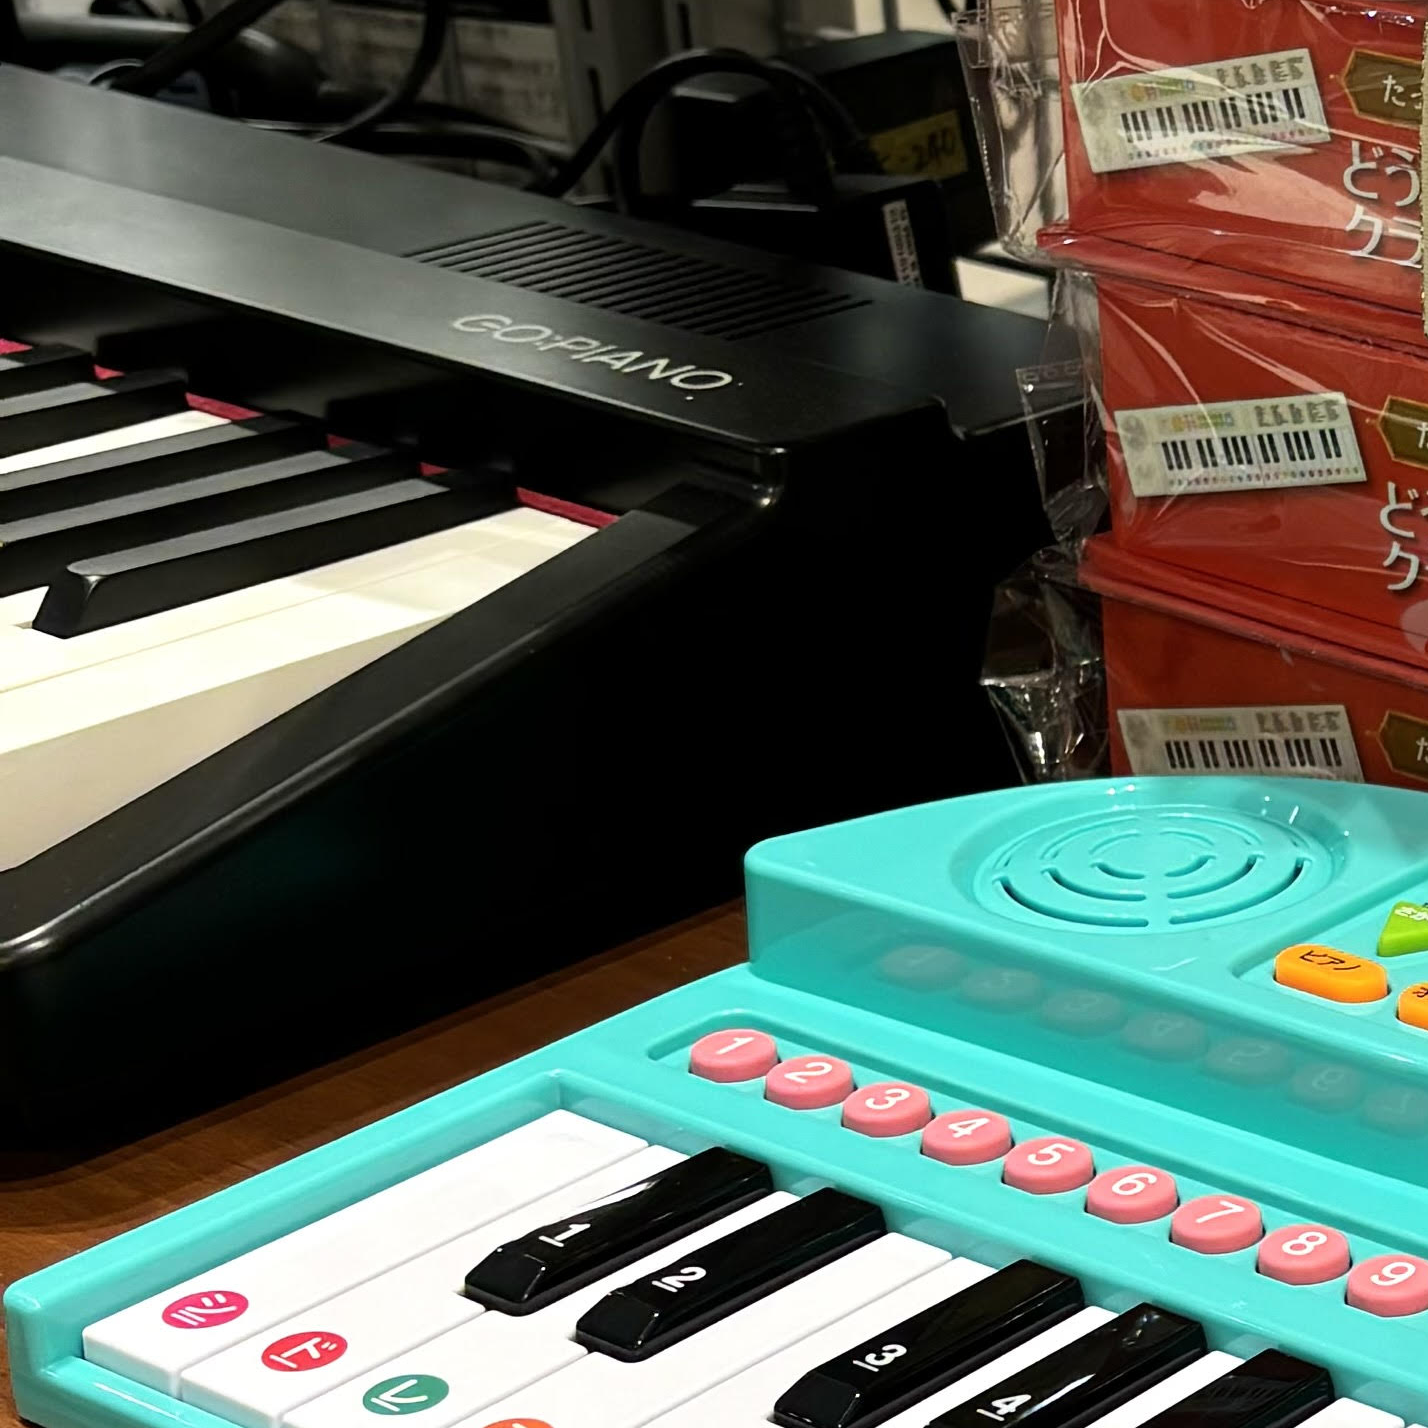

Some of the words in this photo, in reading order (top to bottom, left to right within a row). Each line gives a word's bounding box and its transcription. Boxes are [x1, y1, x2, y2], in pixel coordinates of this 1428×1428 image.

[1299, 948, 1363, 973] ピアノ
[715, 1036, 755, 1056] 1
[784, 1060, 833, 1084] 2
[864, 1088, 911, 1111] 3
[947, 1117, 991, 1139] 4
[1027, 1142, 1075, 1166] 5
[1111, 1172, 1158, 1196] 6
[1196, 1200, 1245, 1225] 7
[1281, 1230, 1328, 1256] 8
[1370, 1261, 1416, 1287] 9
